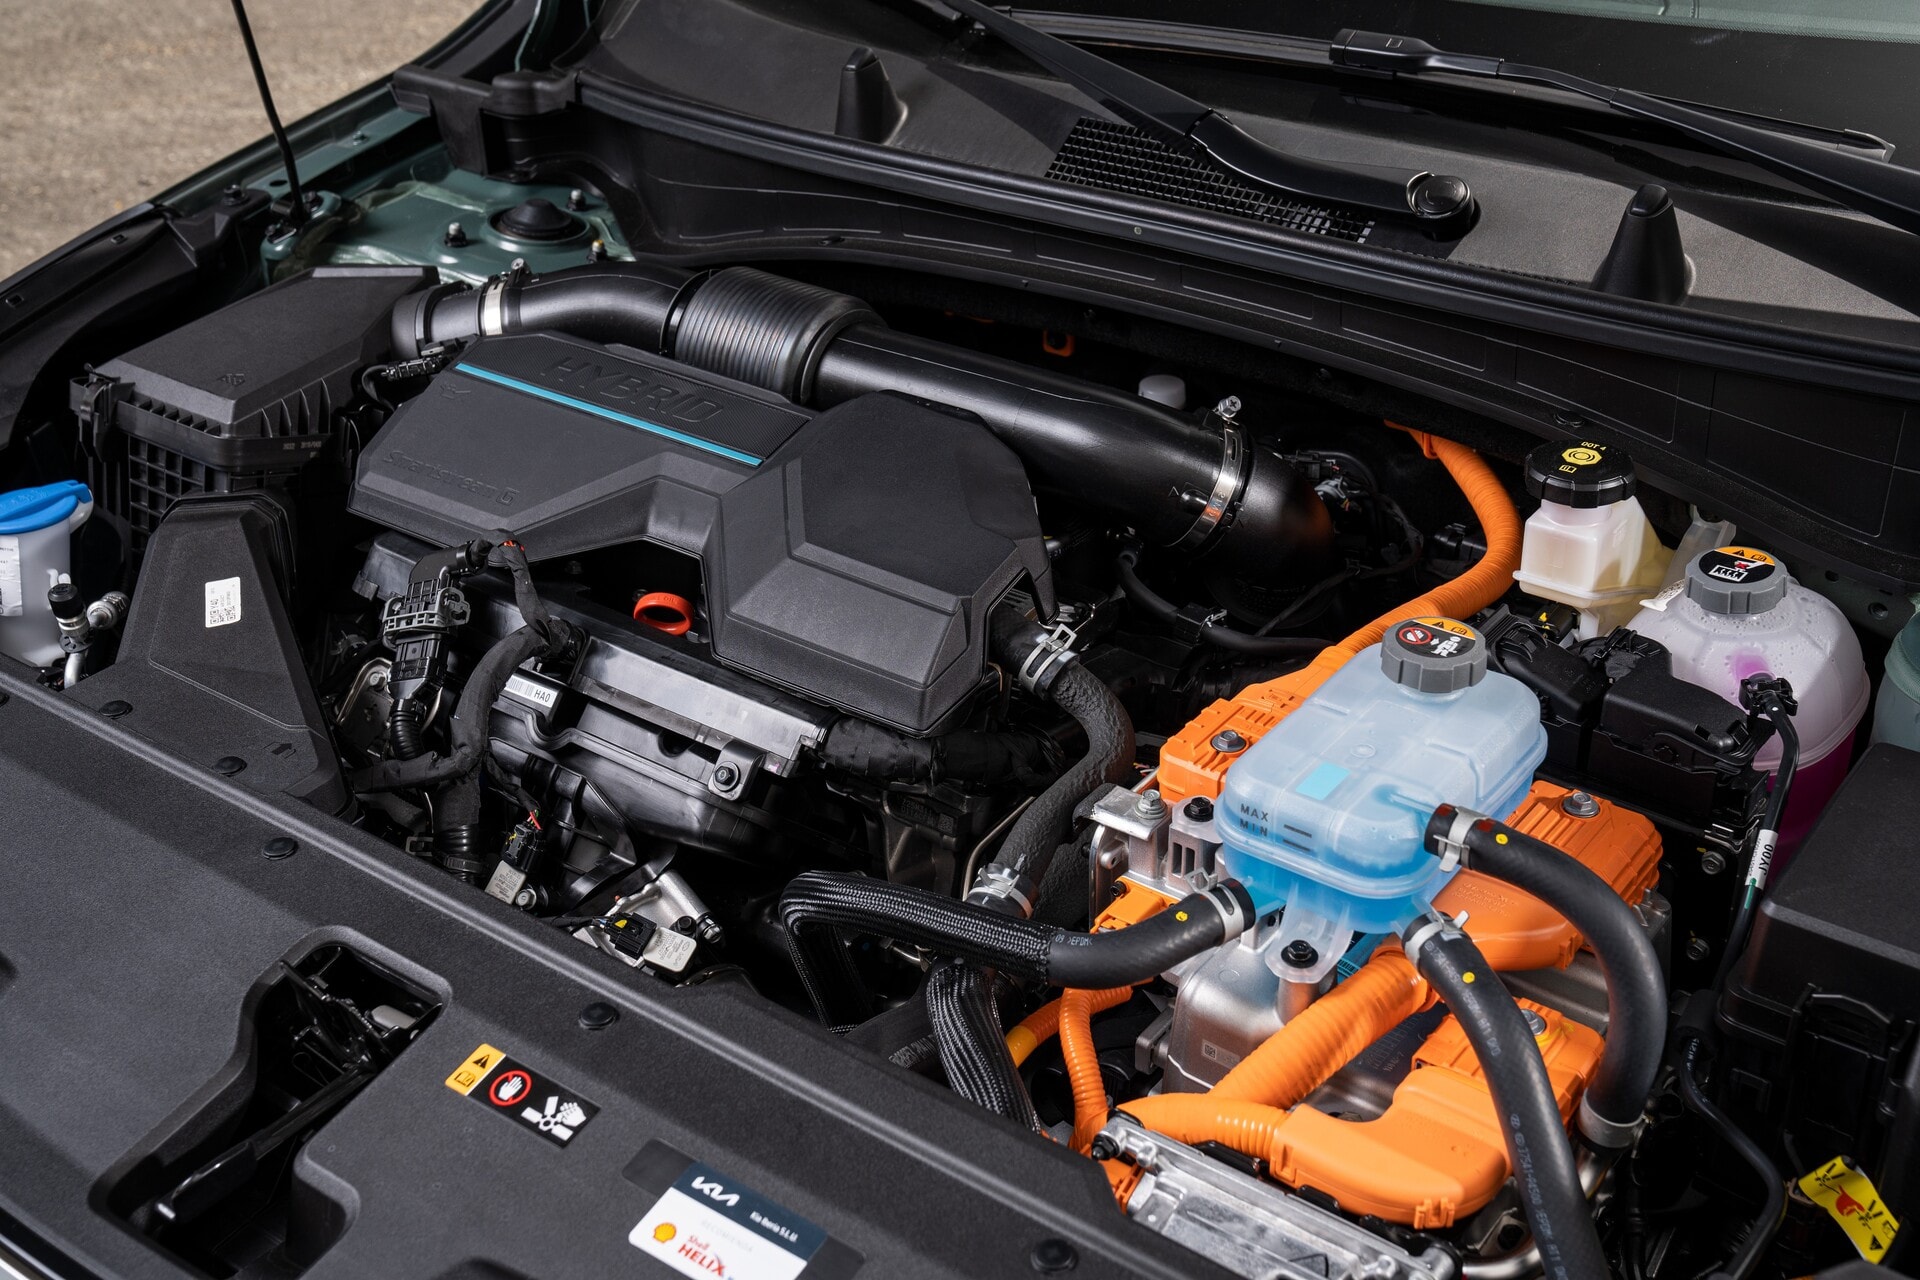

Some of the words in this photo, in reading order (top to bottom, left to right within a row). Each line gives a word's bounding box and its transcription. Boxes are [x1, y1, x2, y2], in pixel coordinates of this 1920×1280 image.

[539, 356, 725, 423] HYBRID
[1581, 441, 1600, 449] DOT
[382, 450, 496, 501] Smartstream
[1239, 818, 1268, 837] MIN
[1240, 803, 1269, 822] MAX
[1758, 844, 1774, 875] JY00
[678, 1244, 725, 1277] HELIX
